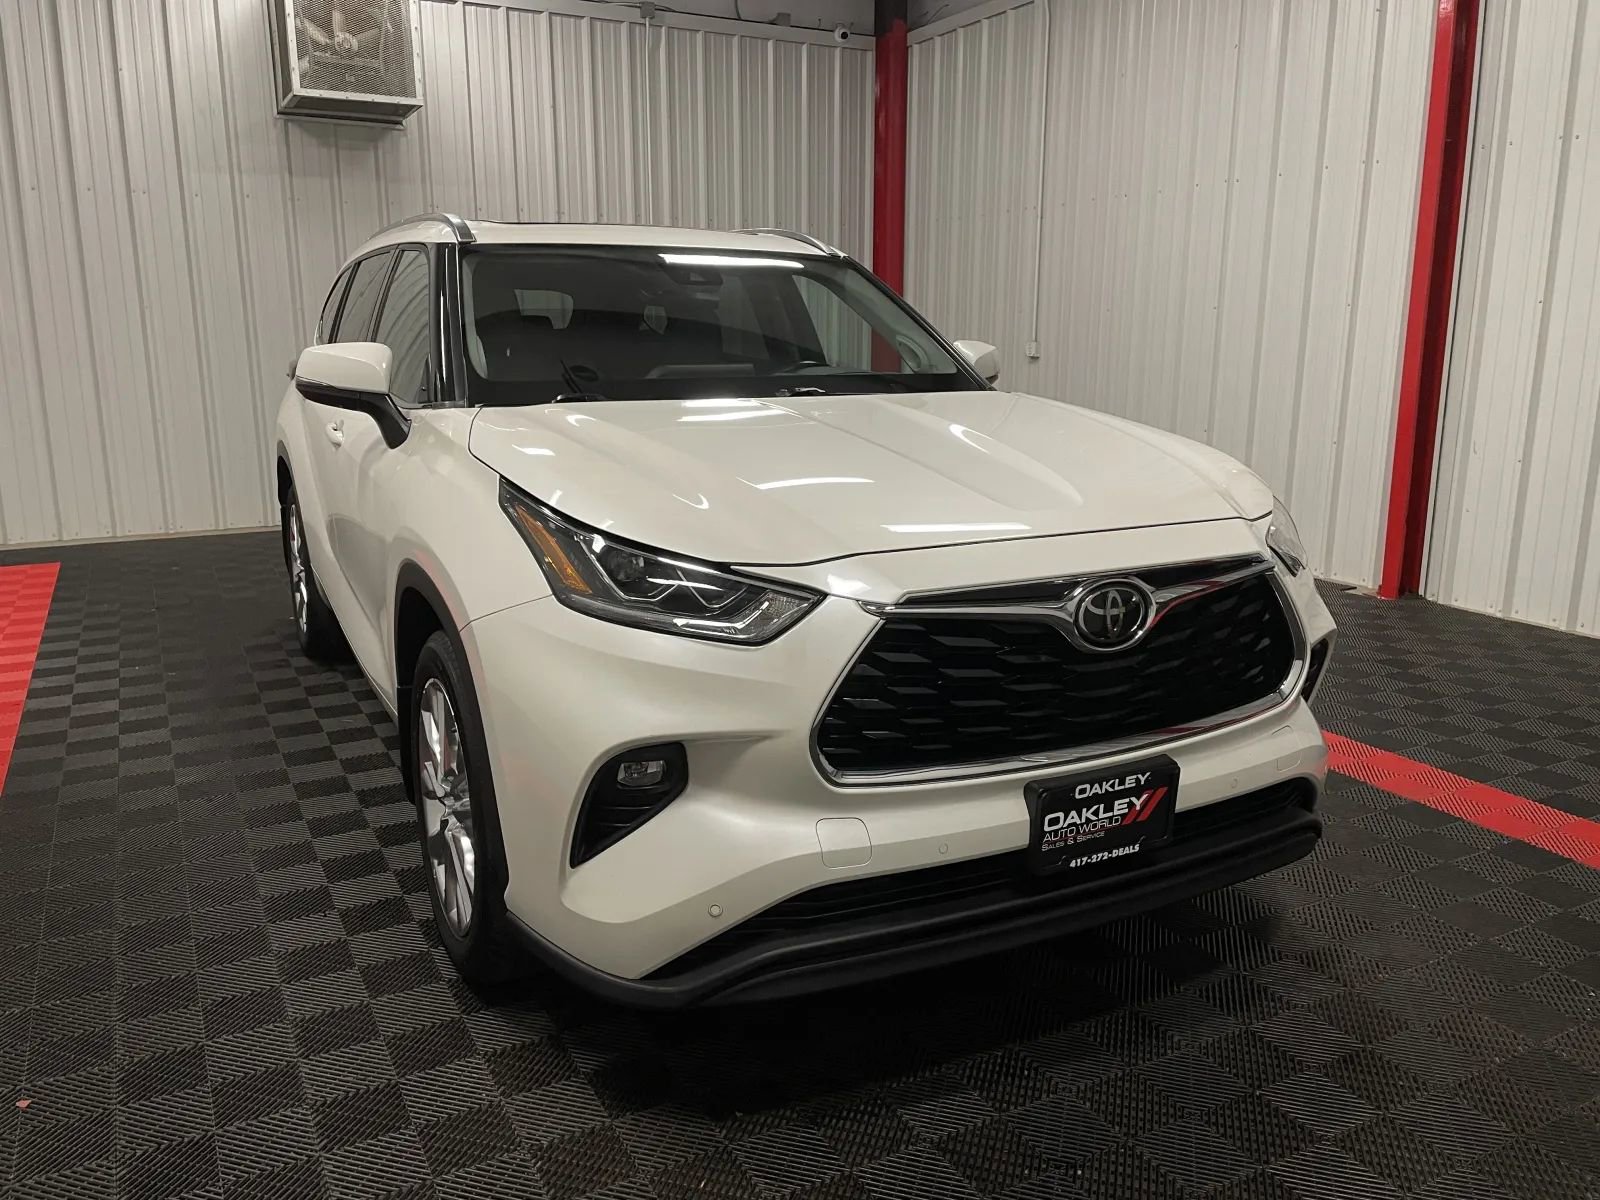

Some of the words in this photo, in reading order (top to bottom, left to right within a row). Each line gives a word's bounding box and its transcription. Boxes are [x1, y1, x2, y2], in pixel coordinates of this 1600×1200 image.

[1075, 772, 1151, 799] OAKLEY
[1044, 792, 1150, 832] OAKLEY
[1043, 827, 1076, 843] AUTO
[1079, 816, 1121, 835] WORLD
[1069, 844, 1140, 868] 417-272-DEALS
